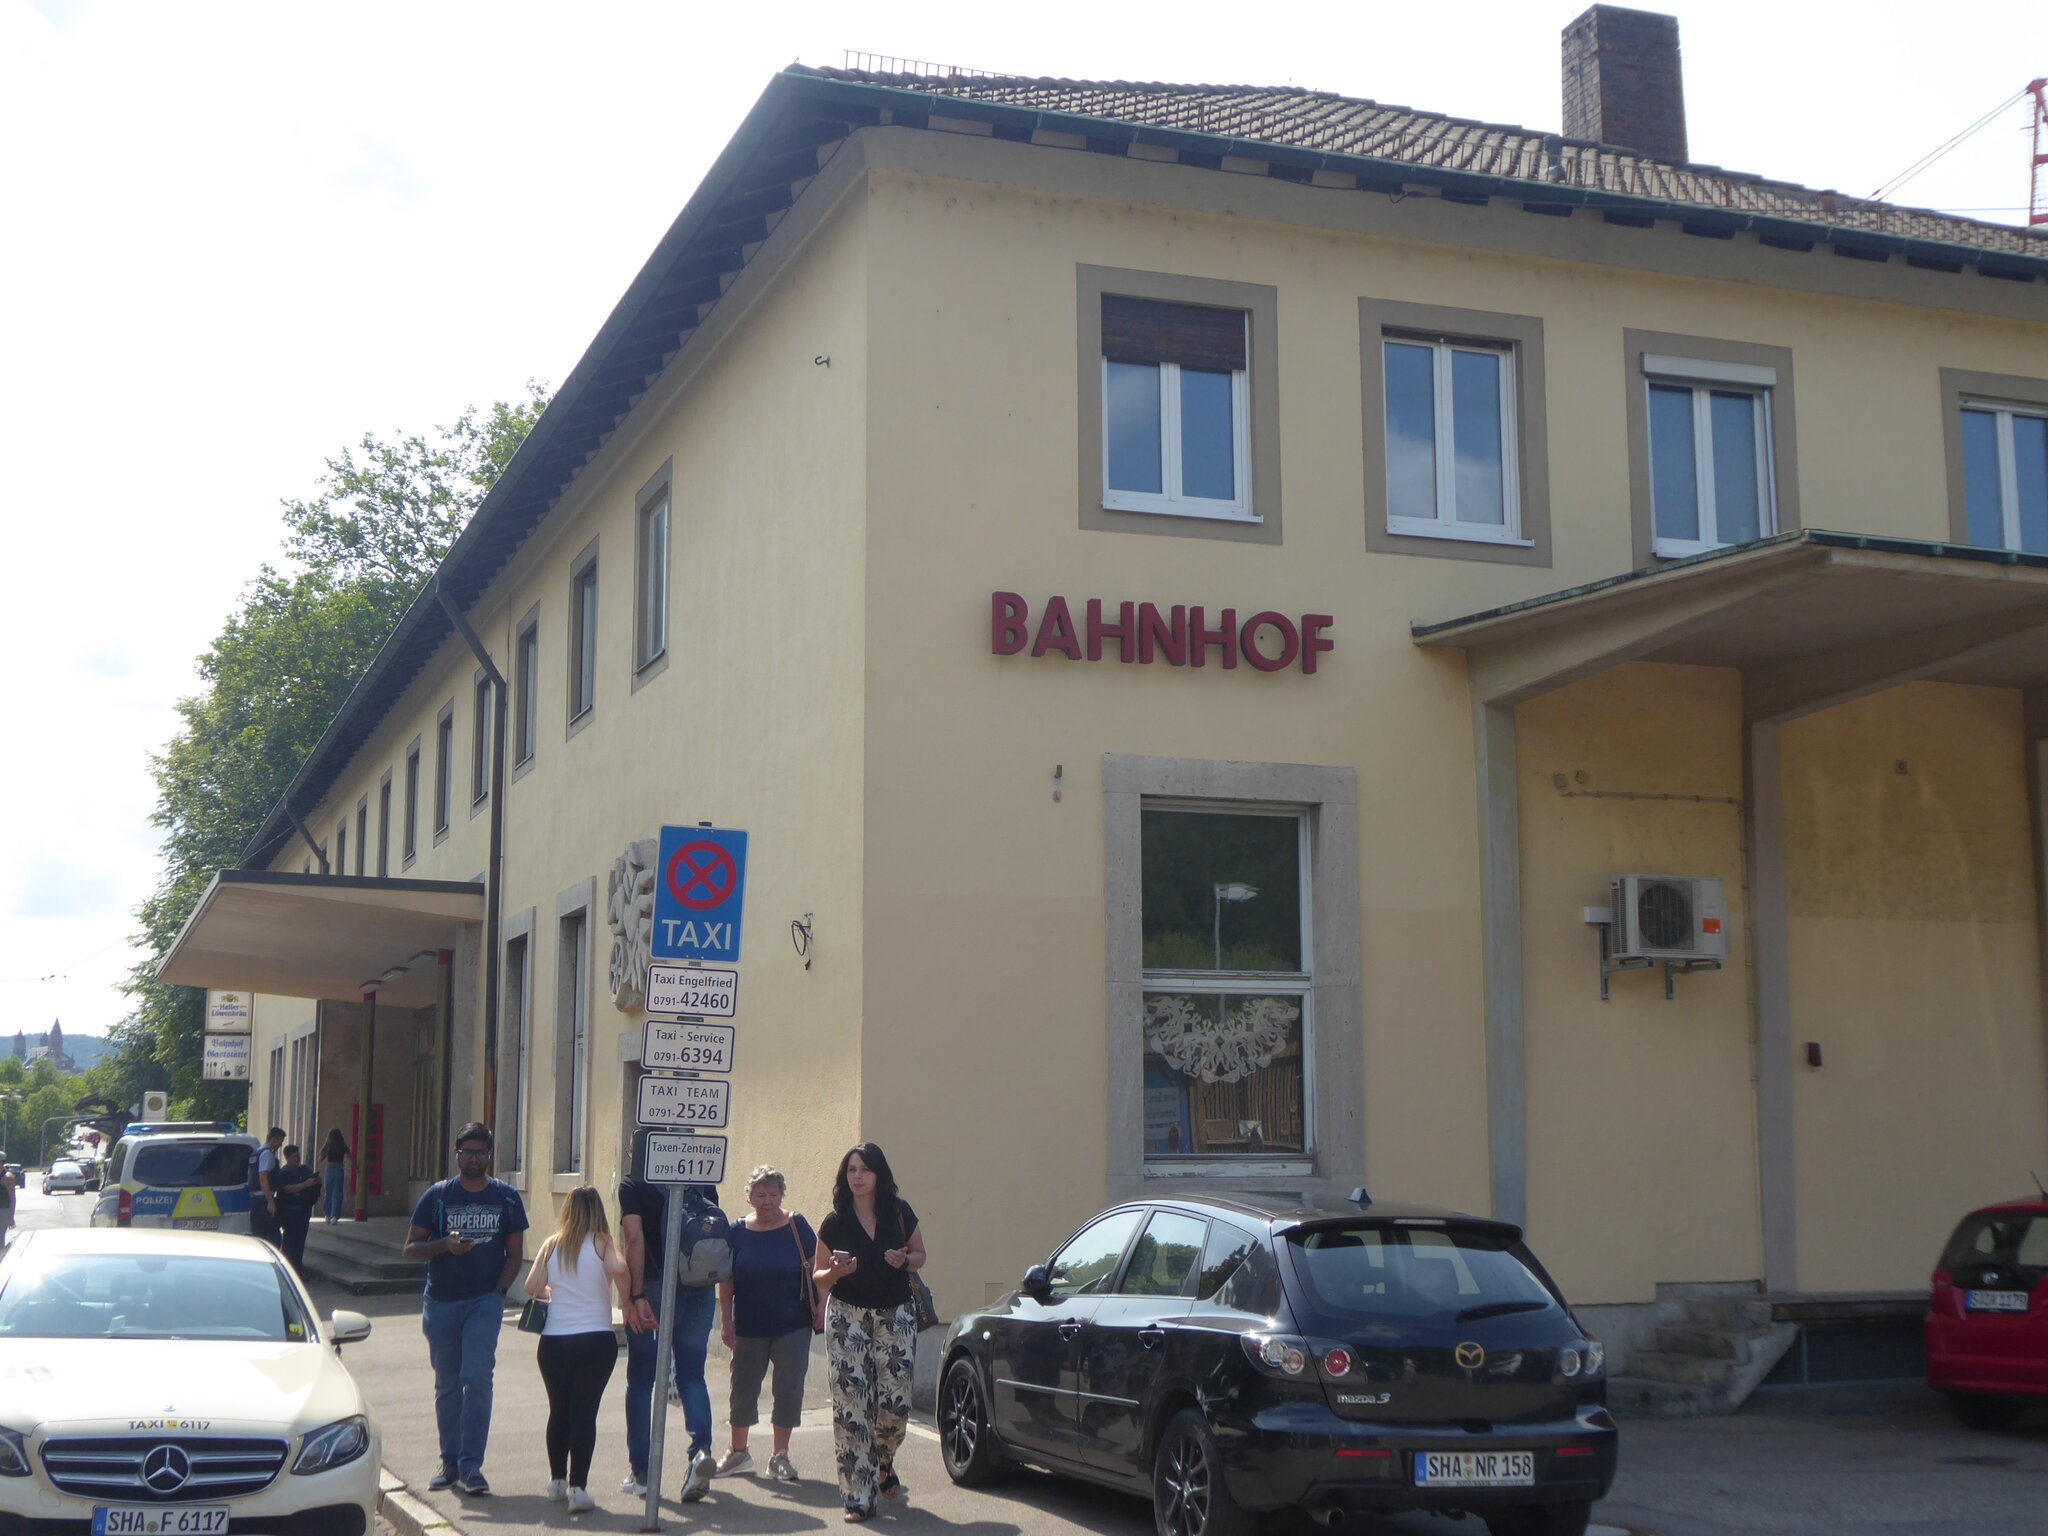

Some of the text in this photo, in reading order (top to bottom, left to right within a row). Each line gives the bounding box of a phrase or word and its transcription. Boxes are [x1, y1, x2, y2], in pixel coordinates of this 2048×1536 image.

[992, 591, 1334, 675] BAHNHOF
[661, 919, 732, 950] TAXI
[654, 973, 733, 991] Taxi Engelfried
[211, 1009, 248, 1017] Löwenbräu
[211, 1038, 244, 1049] Bahnhof
[655, 1029, 677, 1041] Taxi
[686, 1030, 726, 1044] Service
[206, 1049, 248, 1058] Gaststätte
[650, 1085, 720, 1098] TAXI TEAM
[652, 1142, 722, 1156] Taxen-Zentrale
[135, 1196, 173, 1205] POLIZEI
[128, 1419, 211, 1430] TAXI 6117
[1428, 1455, 1462, 1478] SHA
[1475, 1455, 1498, 1478] NR
[1501, 1455, 1532, 1478] 158
[108, 1511, 145, 1532] SHA
[161, 1511, 174, 1532] F
[178, 1510, 227, 1532] 6117
